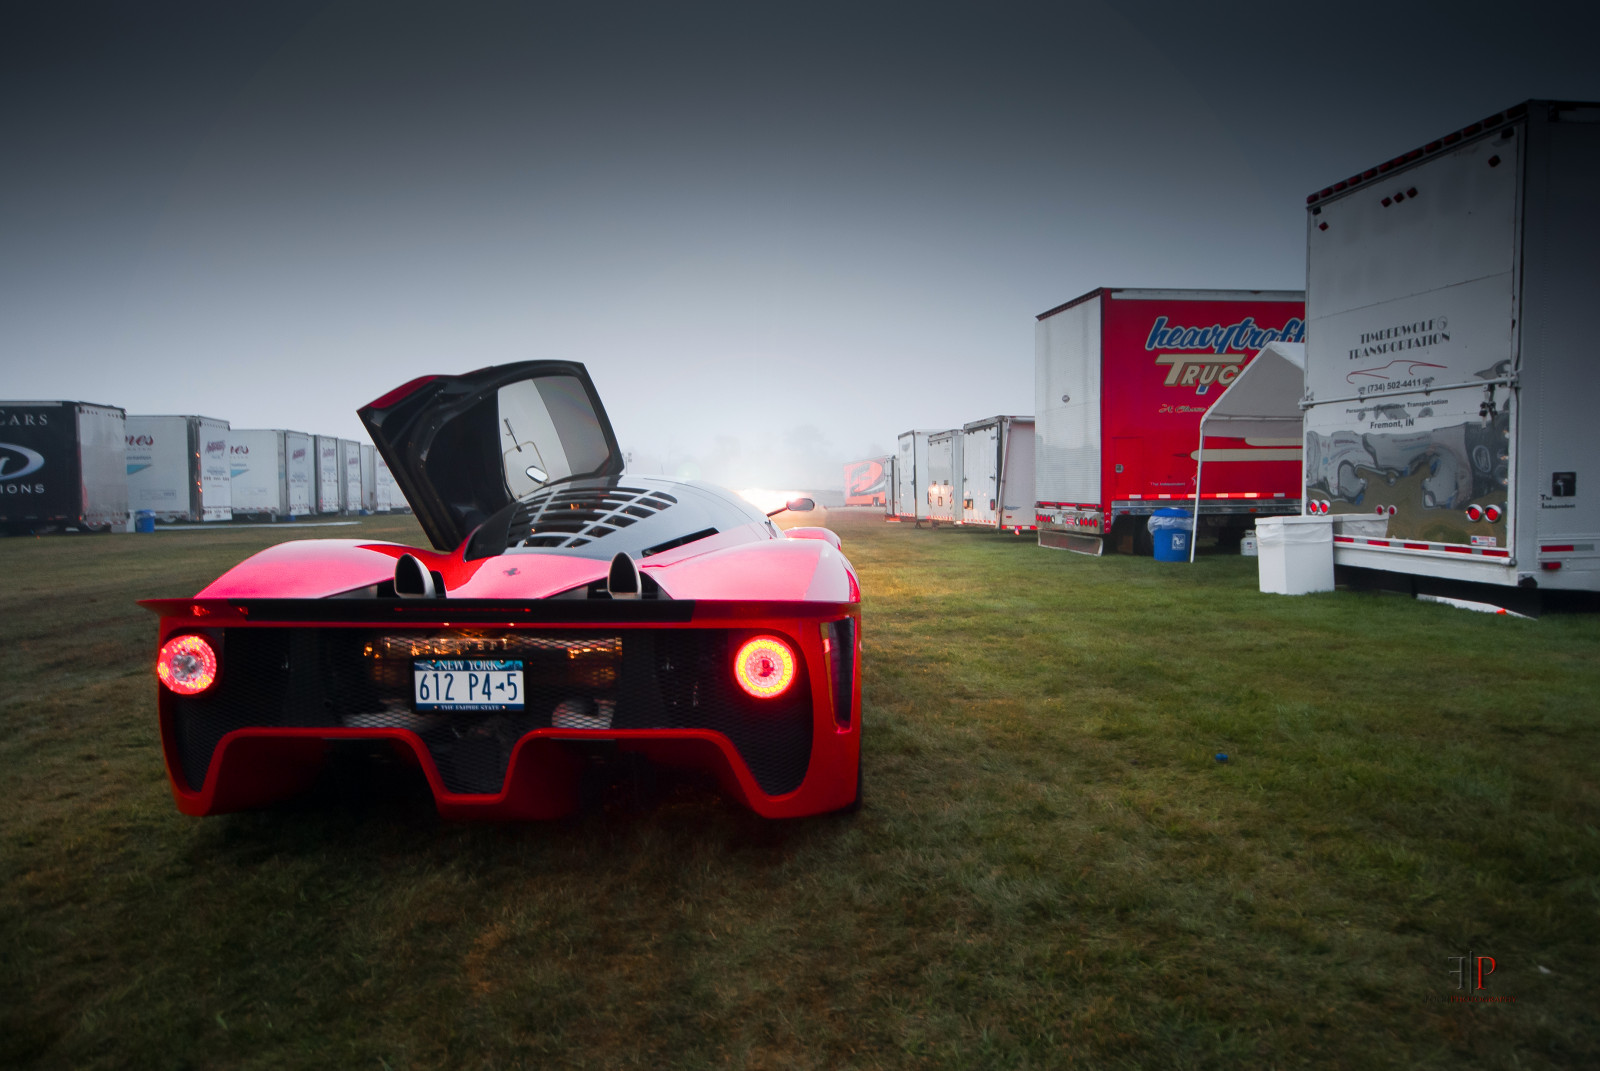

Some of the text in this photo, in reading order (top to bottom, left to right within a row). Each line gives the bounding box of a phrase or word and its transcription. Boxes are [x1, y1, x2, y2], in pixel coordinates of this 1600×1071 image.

[1360, 318, 1436, 345] TIMBERWOLF
[1348, 331, 1450, 360] TRANSPORTATION
[1367, 378, 1421, 394] (734) 502-4411
[1407, 399, 1449, 408] Transportation
[1370, 418, 1415, 430] Fremont, IN
[439, 660, 499, 671] NEW YORK
[419, 672, 455, 701] 612
